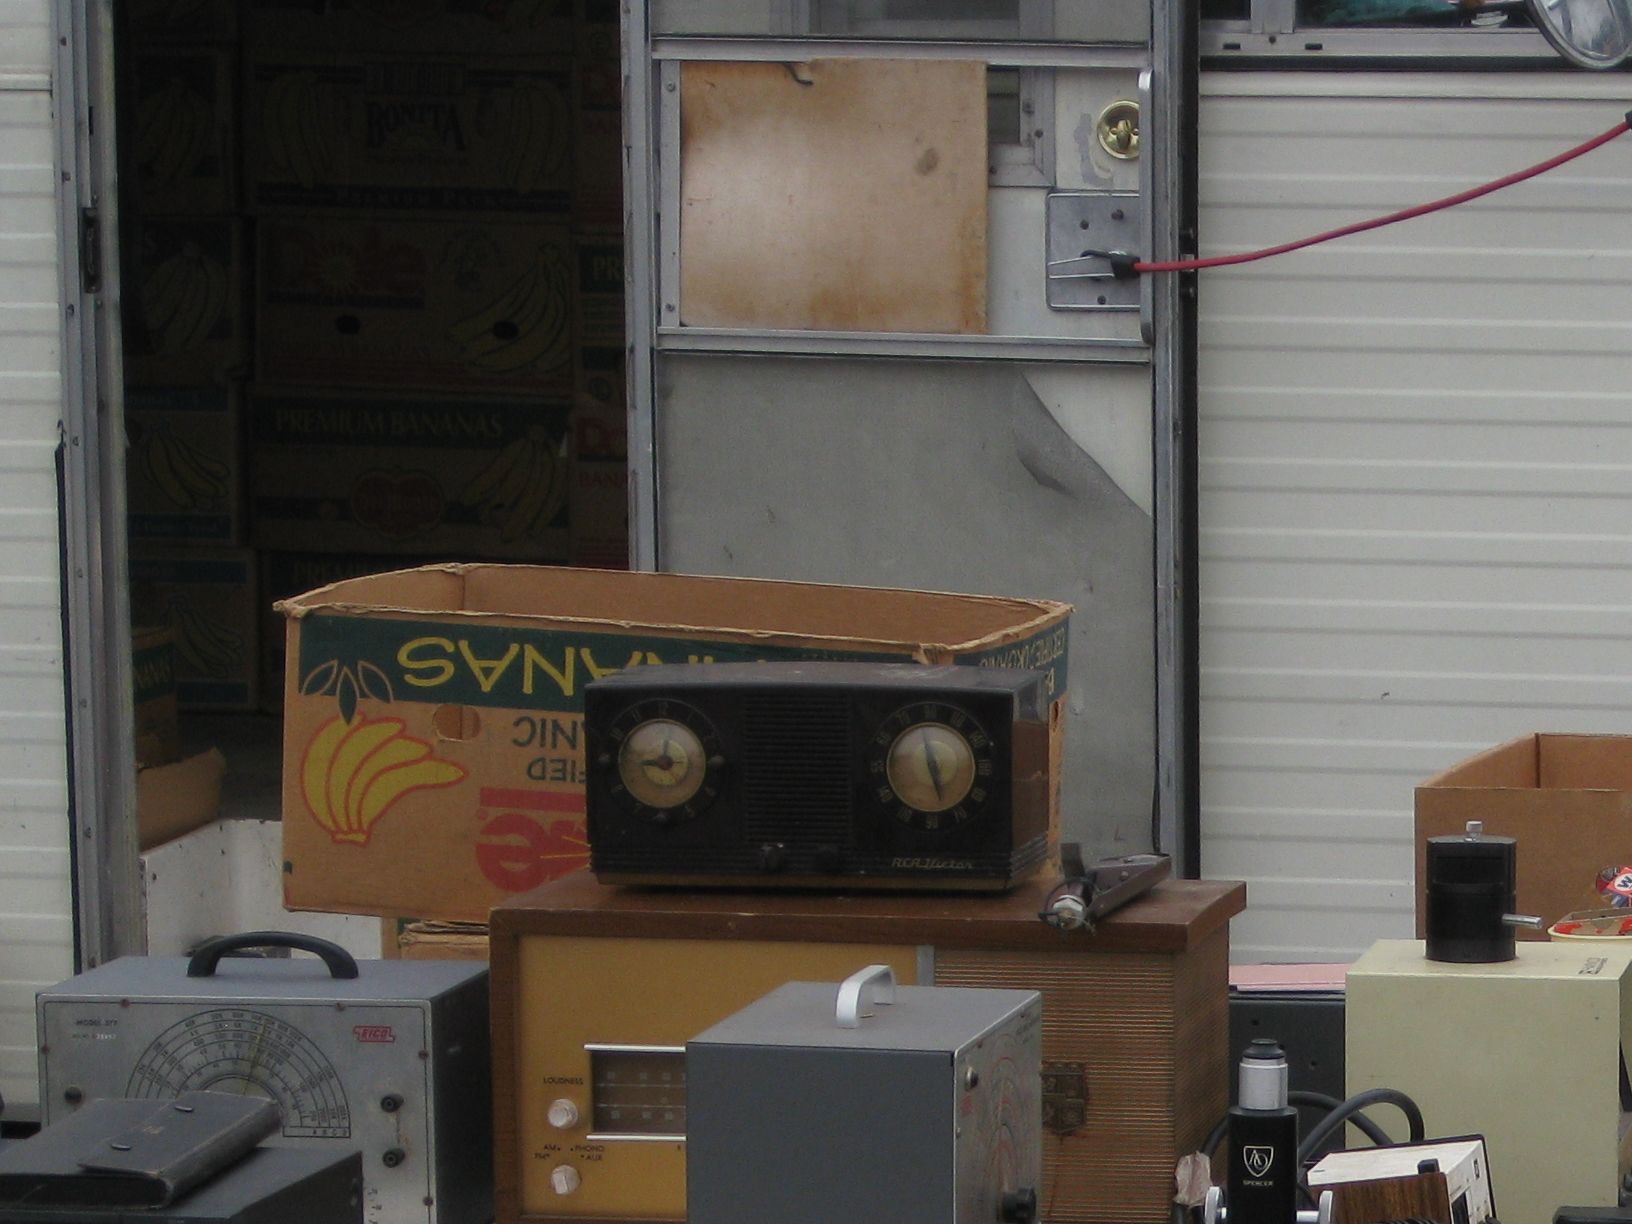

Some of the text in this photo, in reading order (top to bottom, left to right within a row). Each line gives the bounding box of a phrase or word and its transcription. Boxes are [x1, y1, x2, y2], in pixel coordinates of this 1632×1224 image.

[367, 102, 466, 151] BONITA
[276, 409, 504, 437] PREMIUM BANANAS
[543, 1077, 584, 1085] LOUDNESS
